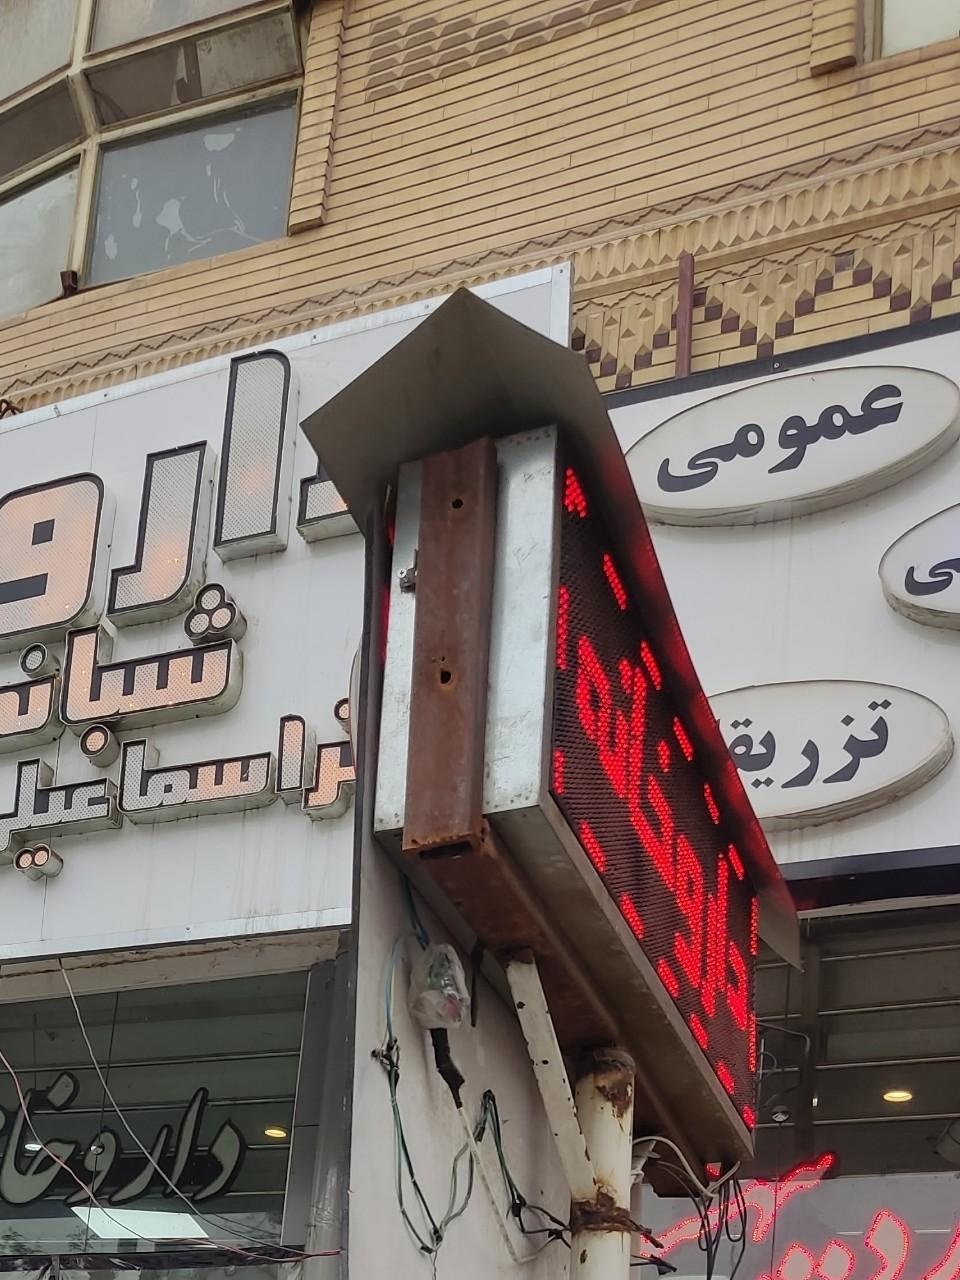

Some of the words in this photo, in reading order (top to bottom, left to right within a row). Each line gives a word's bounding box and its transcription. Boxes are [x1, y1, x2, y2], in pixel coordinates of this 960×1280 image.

[657, 383, 903, 493] عمومی
[720, 698, 893, 790] تزریق
[577, 636, 749, 1030] داروخانه
